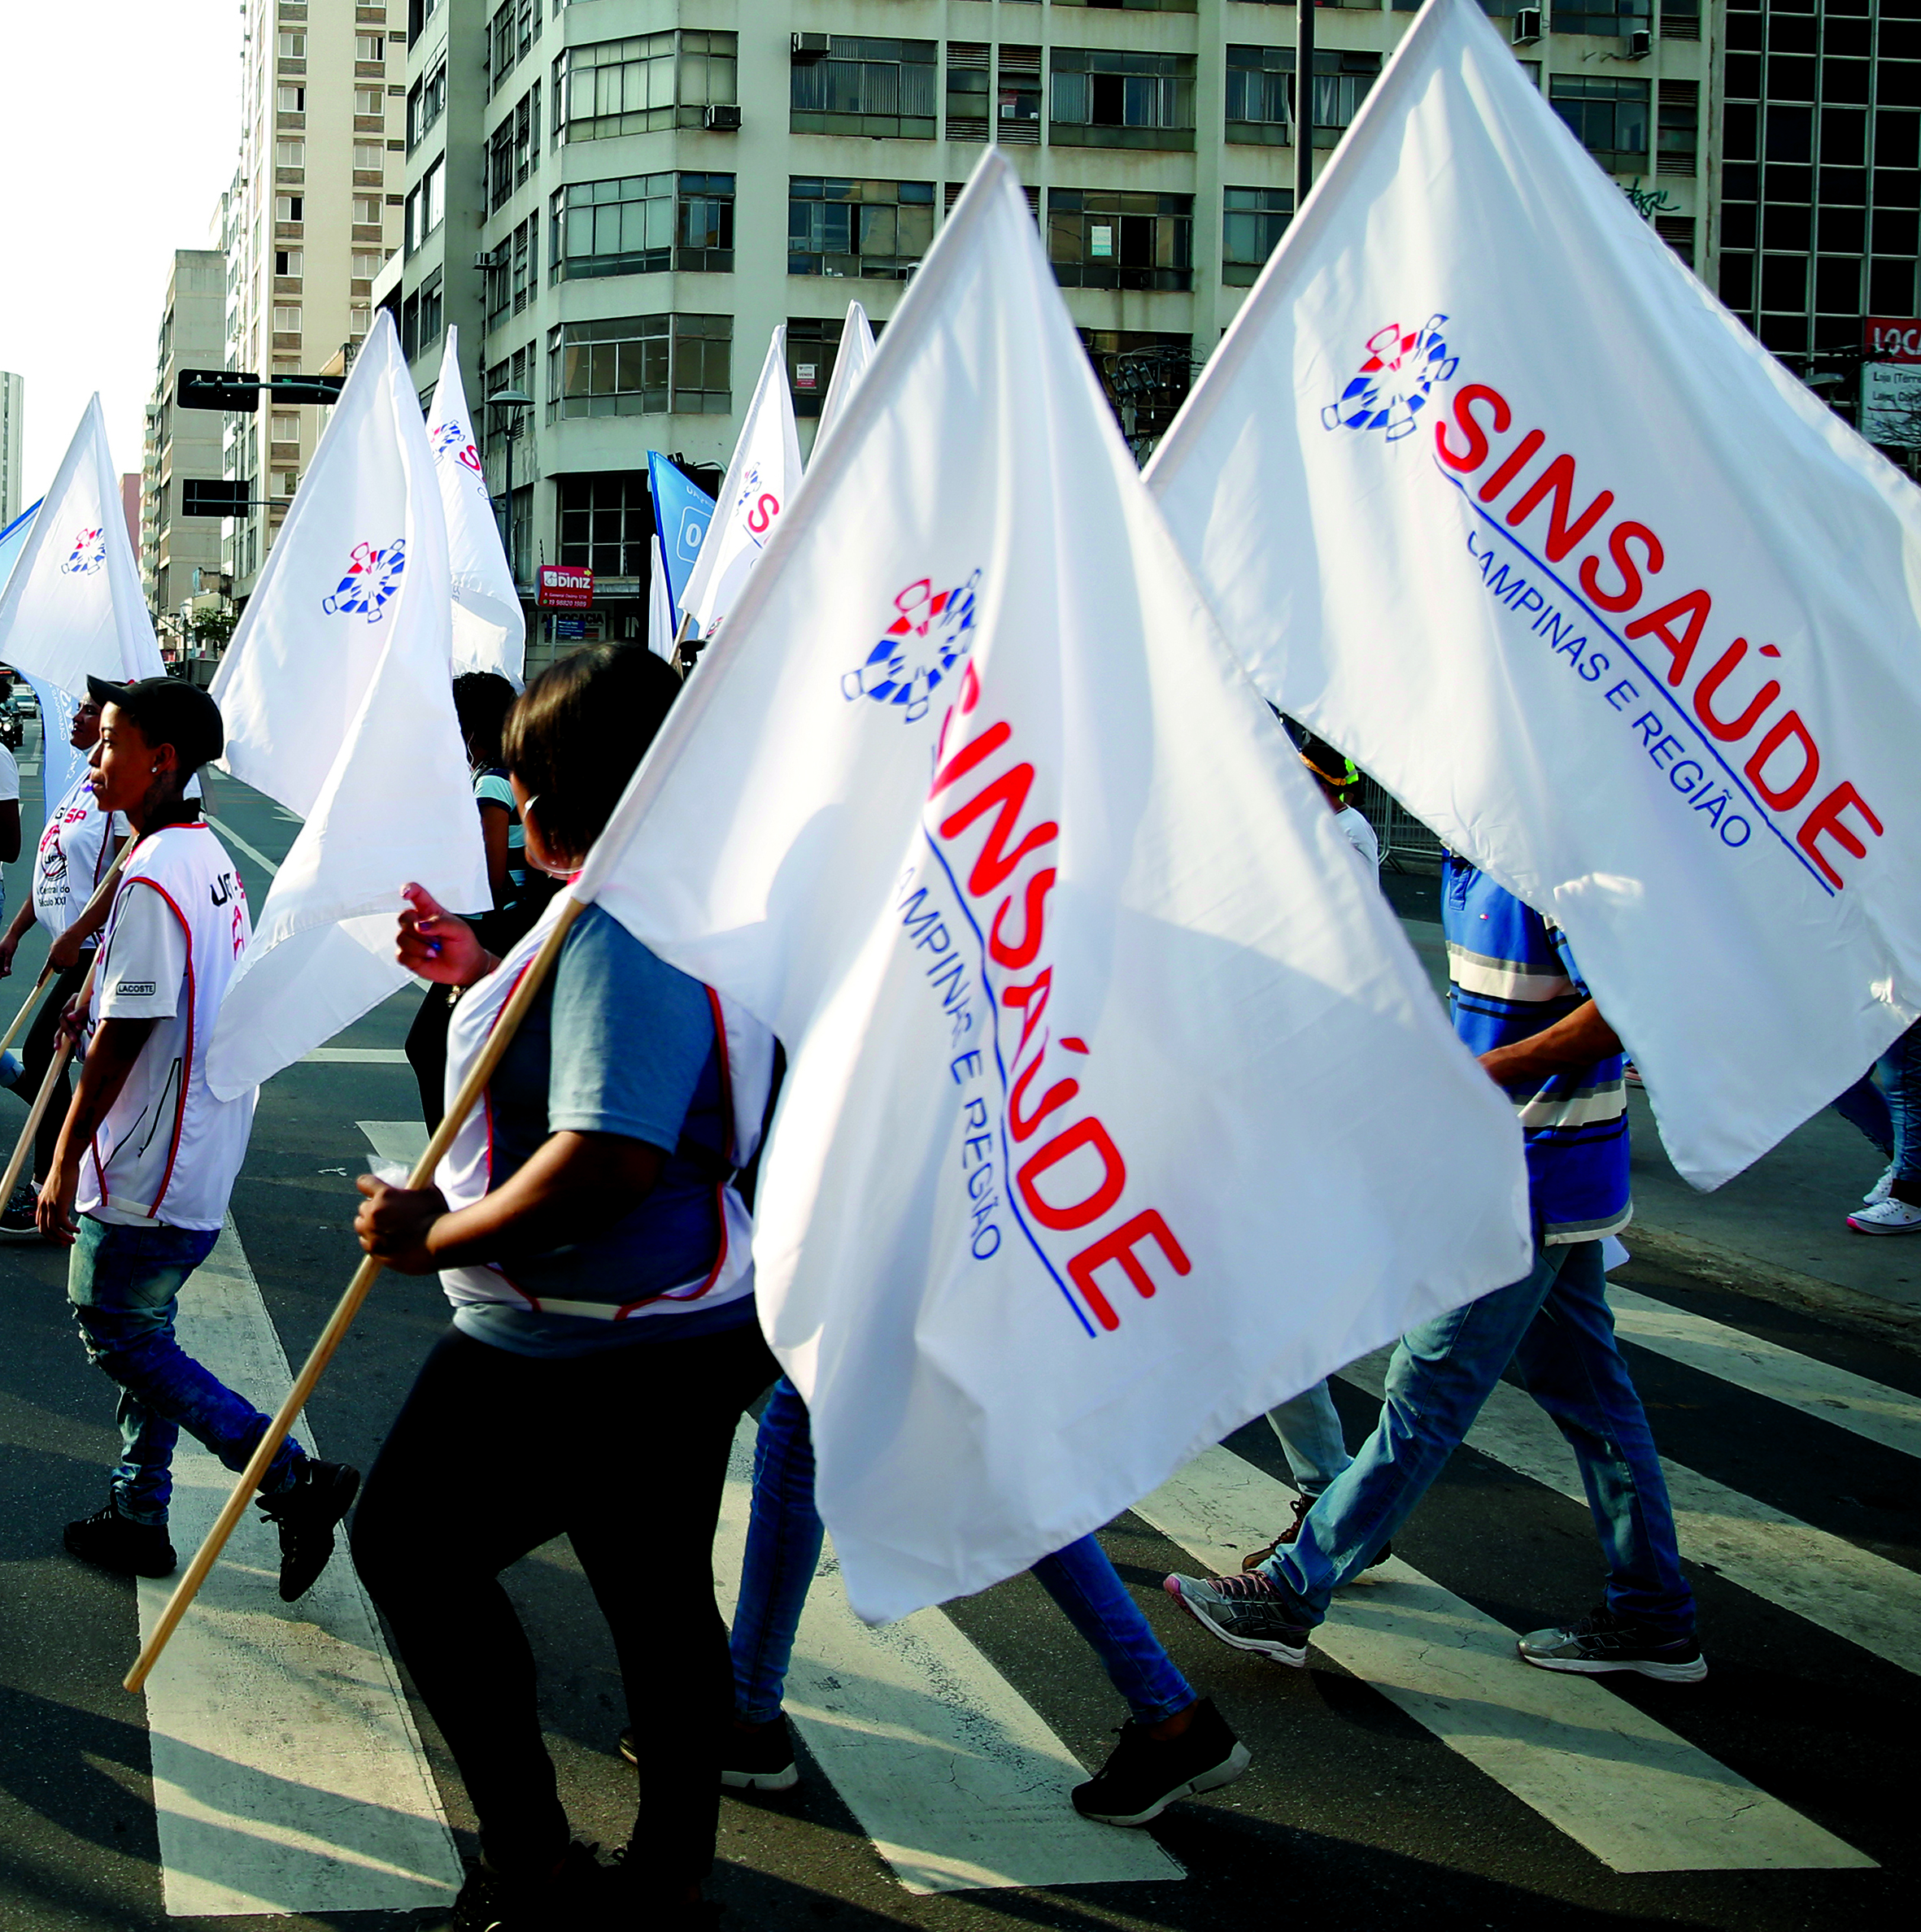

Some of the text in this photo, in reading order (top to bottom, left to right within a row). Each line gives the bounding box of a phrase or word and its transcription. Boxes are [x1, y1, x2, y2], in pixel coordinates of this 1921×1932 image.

[1874, 327, 1921, 355] LOC
[558, 576, 590, 589] DINIZ
[1435, 384, 1883, 890] SINSAÚDE
[1605, 681, 1639, 711] E
[1631, 711, 1752, 848] REGIÃO
[59, 885, 70, 893] do
[54, 896, 67, 906] XXI
[119, 984, 154, 993] LACOSTE
[951, 1050, 982, 1085] E
